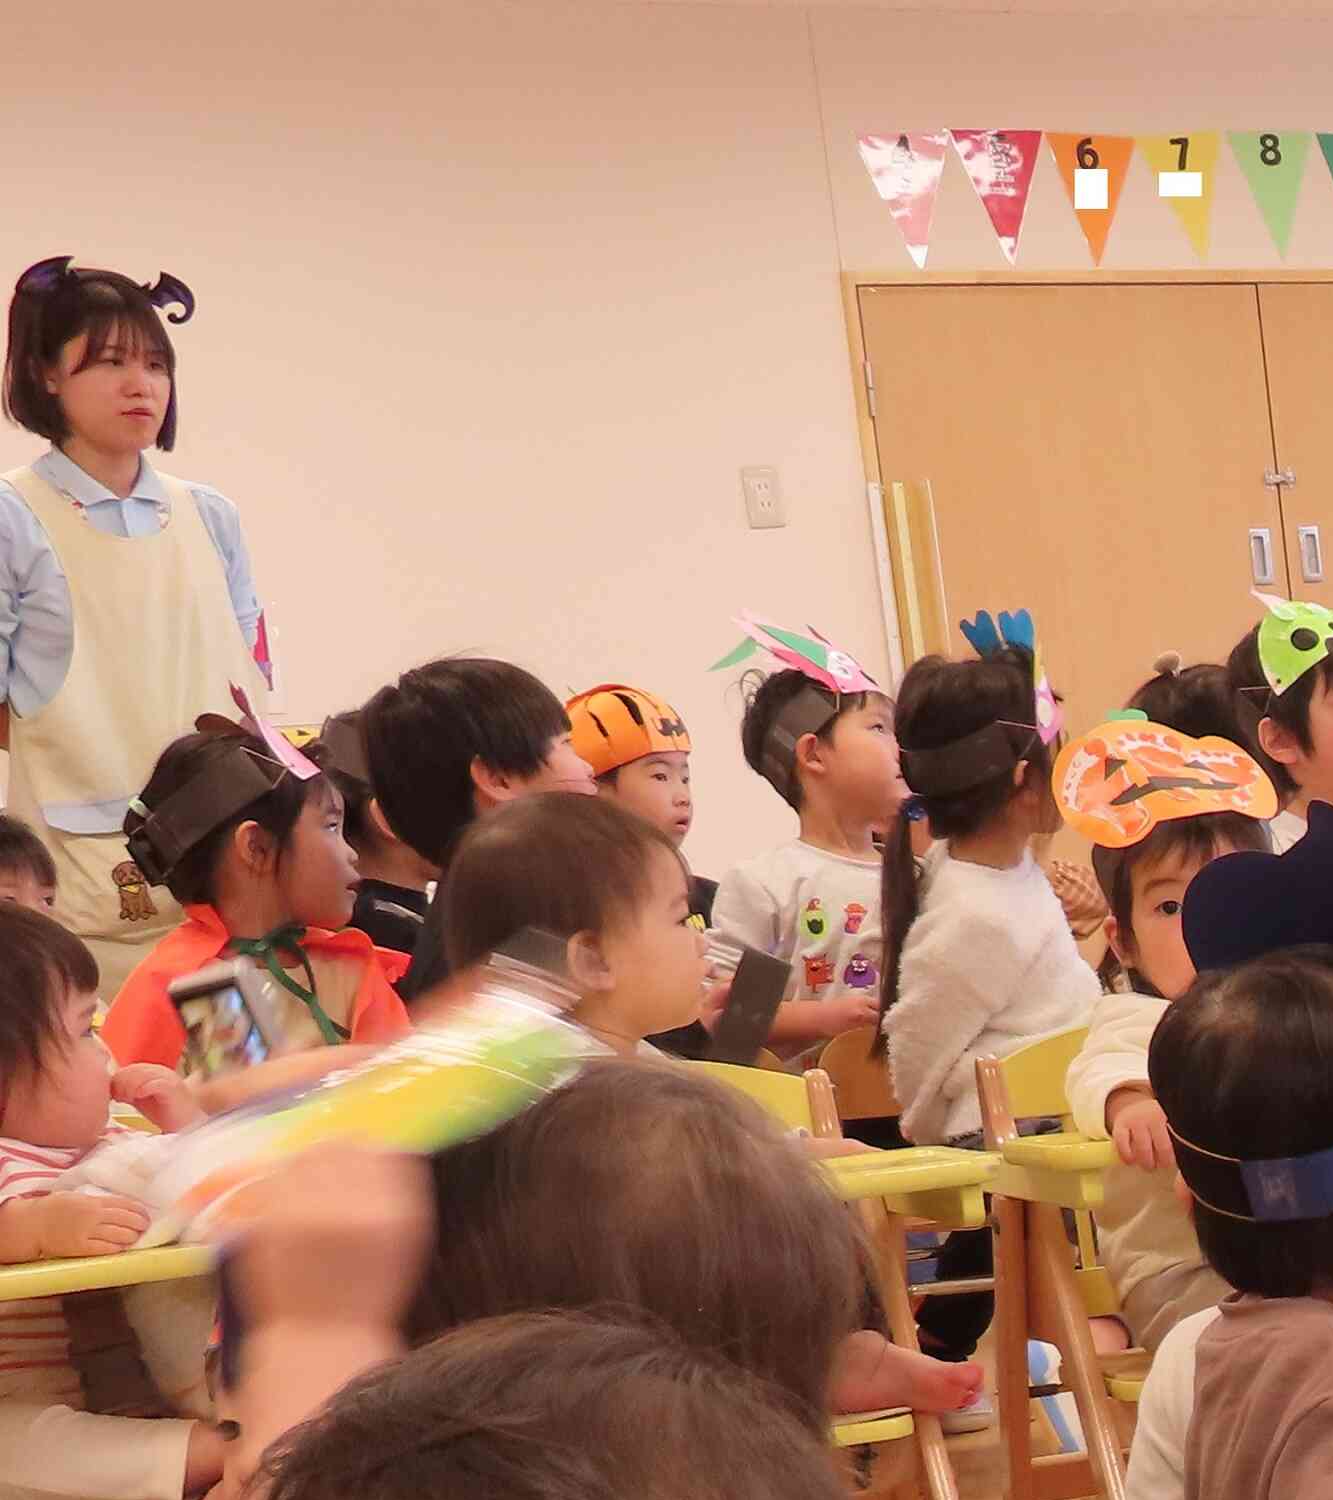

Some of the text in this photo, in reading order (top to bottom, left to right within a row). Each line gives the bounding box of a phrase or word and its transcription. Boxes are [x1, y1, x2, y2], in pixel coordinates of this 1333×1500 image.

[1076, 137, 1099, 169] 6
[1169, 137, 1190, 171] 7
[1259, 133, 1282, 167] 8
